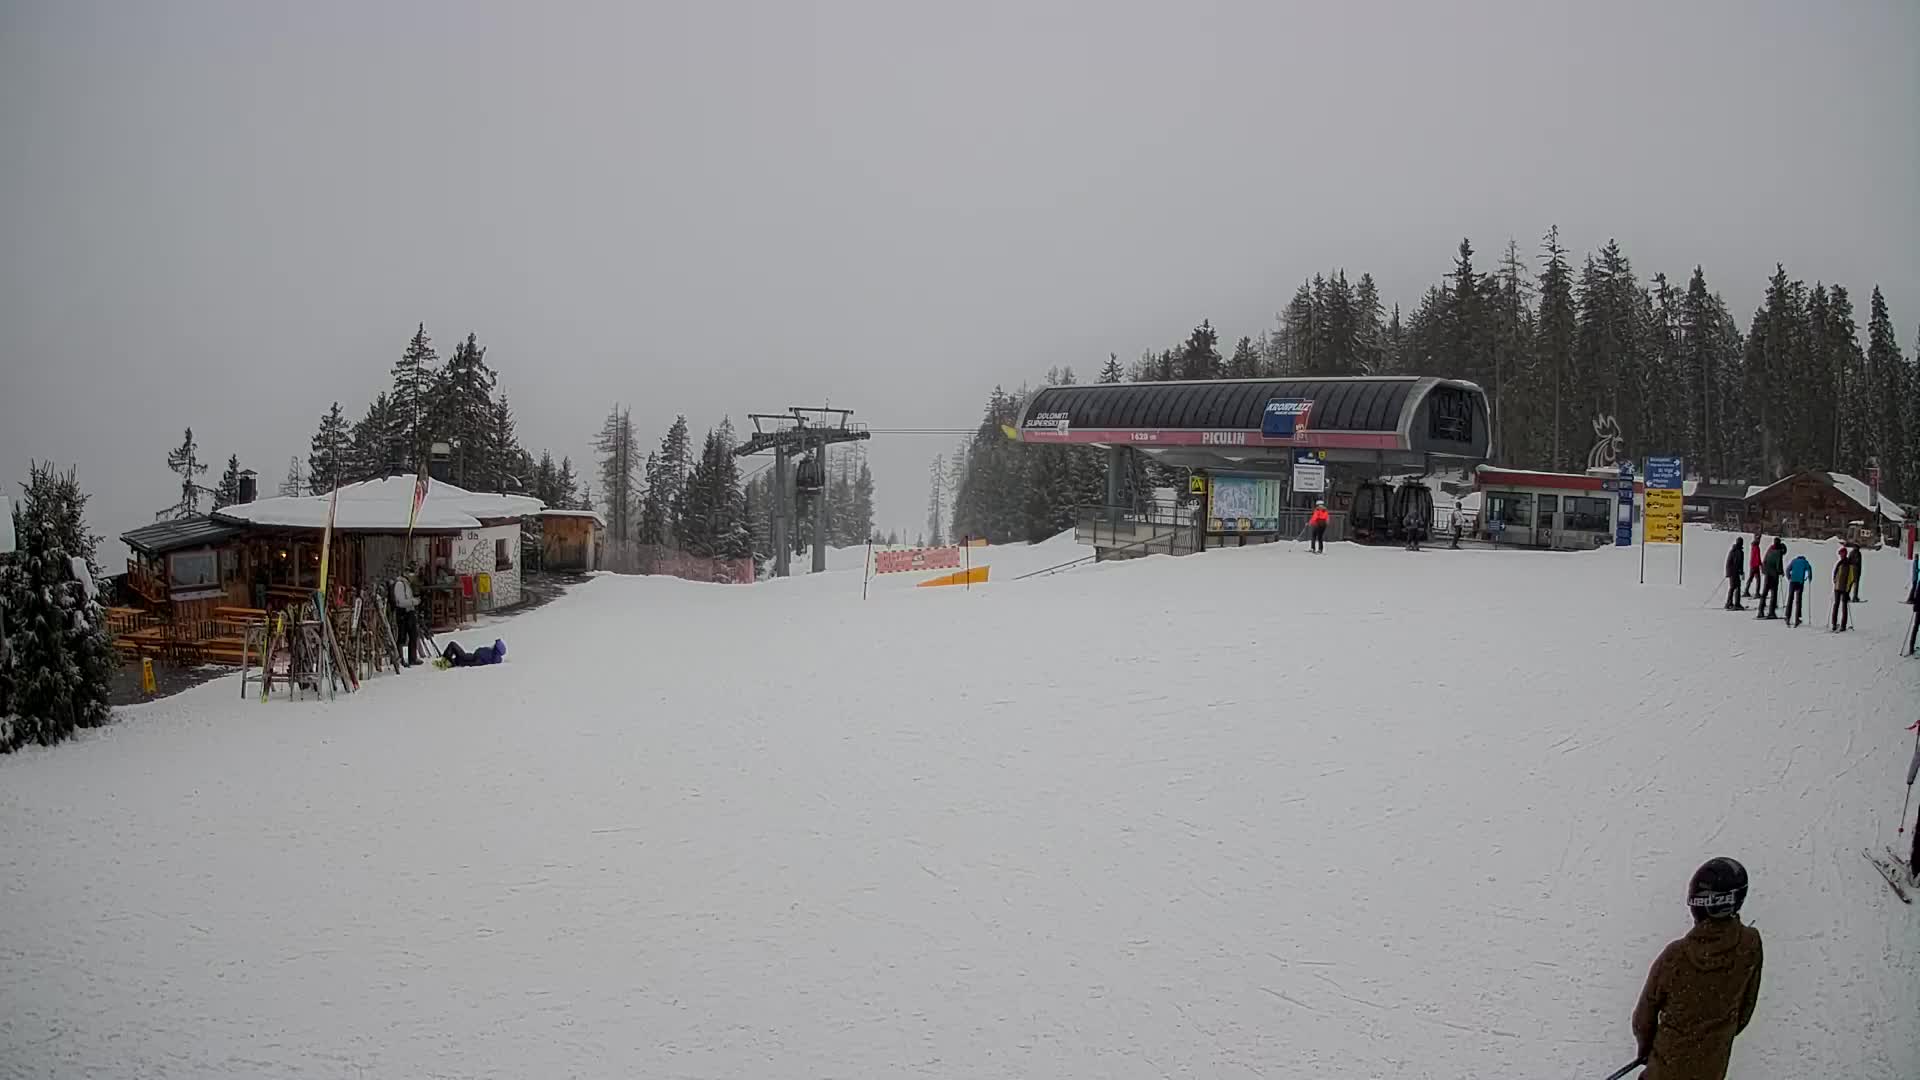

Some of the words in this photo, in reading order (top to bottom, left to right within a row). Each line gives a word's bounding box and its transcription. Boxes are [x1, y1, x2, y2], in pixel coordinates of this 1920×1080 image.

[1036, 412, 1069, 420] DOLOMITI
[1025, 419, 1059, 427] SUPERSKI
[1201, 432, 1245, 445] PICULIN
